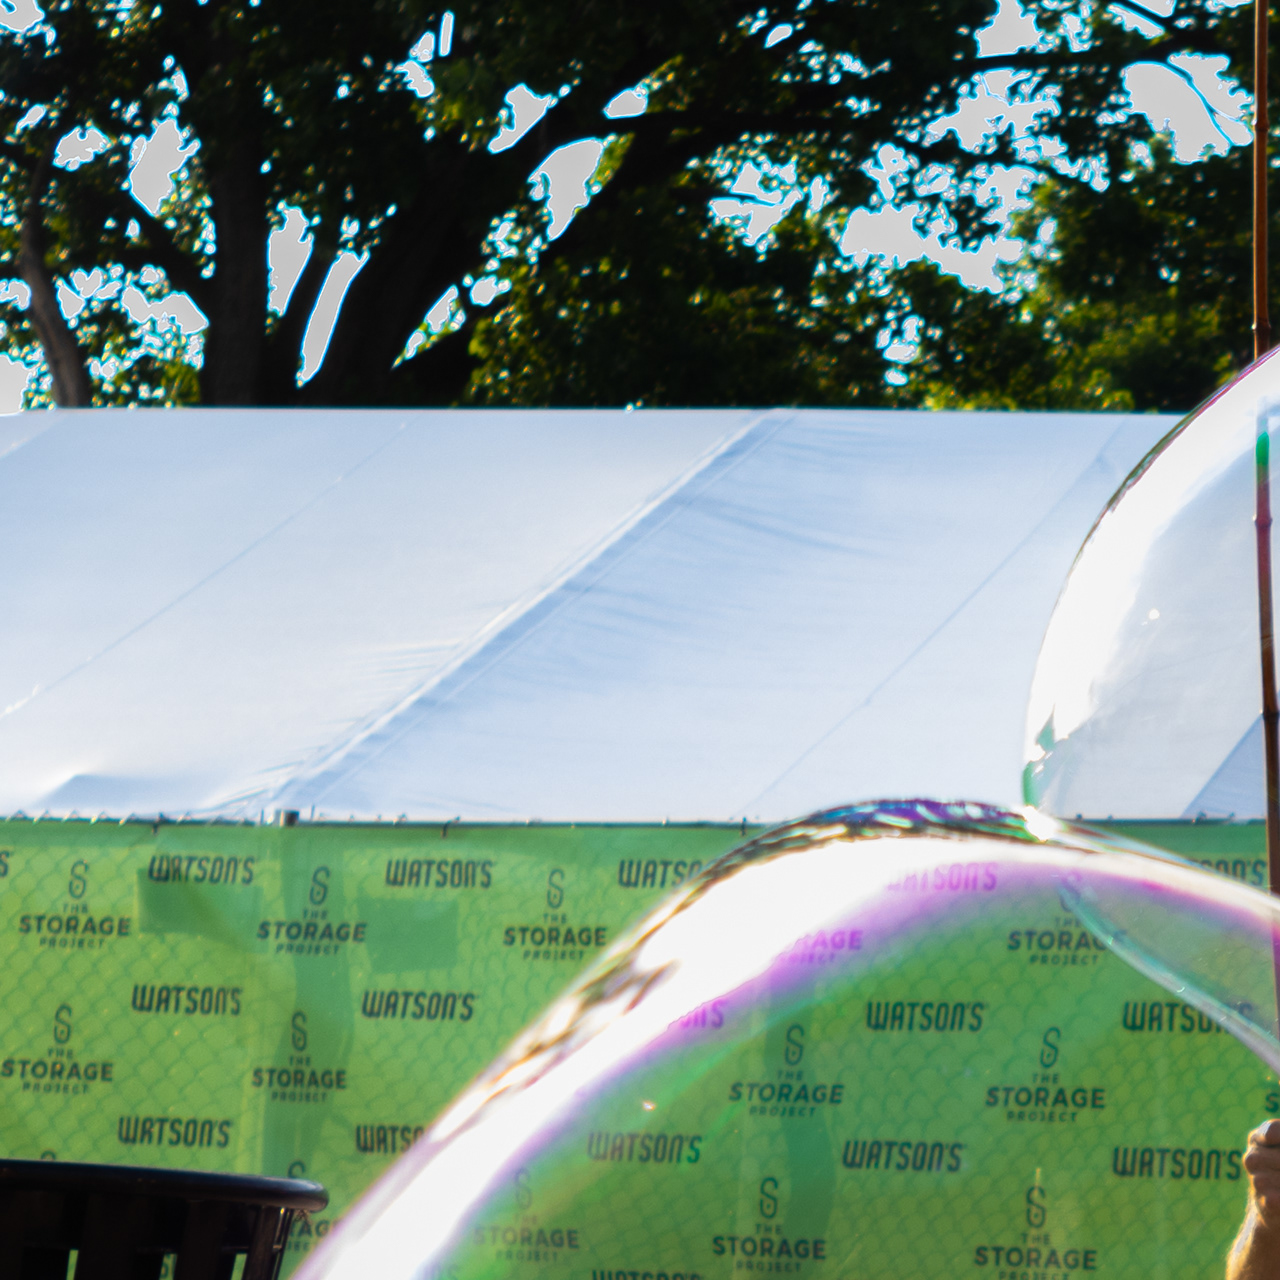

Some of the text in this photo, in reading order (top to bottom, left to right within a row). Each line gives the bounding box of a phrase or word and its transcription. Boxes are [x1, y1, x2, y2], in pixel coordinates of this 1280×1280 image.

[148, 855, 254, 884] WATSON'S
[387, 859, 492, 888] WATSON'S
[19, 916, 130, 936] STORAGE
[257, 922, 366, 942] STORAGE
[503, 927, 606, 946] STORAGE
[132, 985, 241, 1015] WATSON'S
[362, 990, 475, 1021] WATSON'S
[867, 1001, 985, 1032] WATSON'S
[2, 1061, 113, 1081] STORAGE
[252, 1068, 346, 1089] STORAGE
[729, 1083, 844, 1104] STORAGE
[986, 1087, 1106, 1108] STORAGE
[118, 1117, 231, 1148] WATSON'S
[588, 1133, 701, 1163] WATSON'S
[843, 1140, 962, 1172] WATSON'S
[1113, 1147, 1242, 1180] WATSON'S
[713, 1237, 826, 1259] STORAGE
[974, 1247, 1097, 1270] STORAGE
